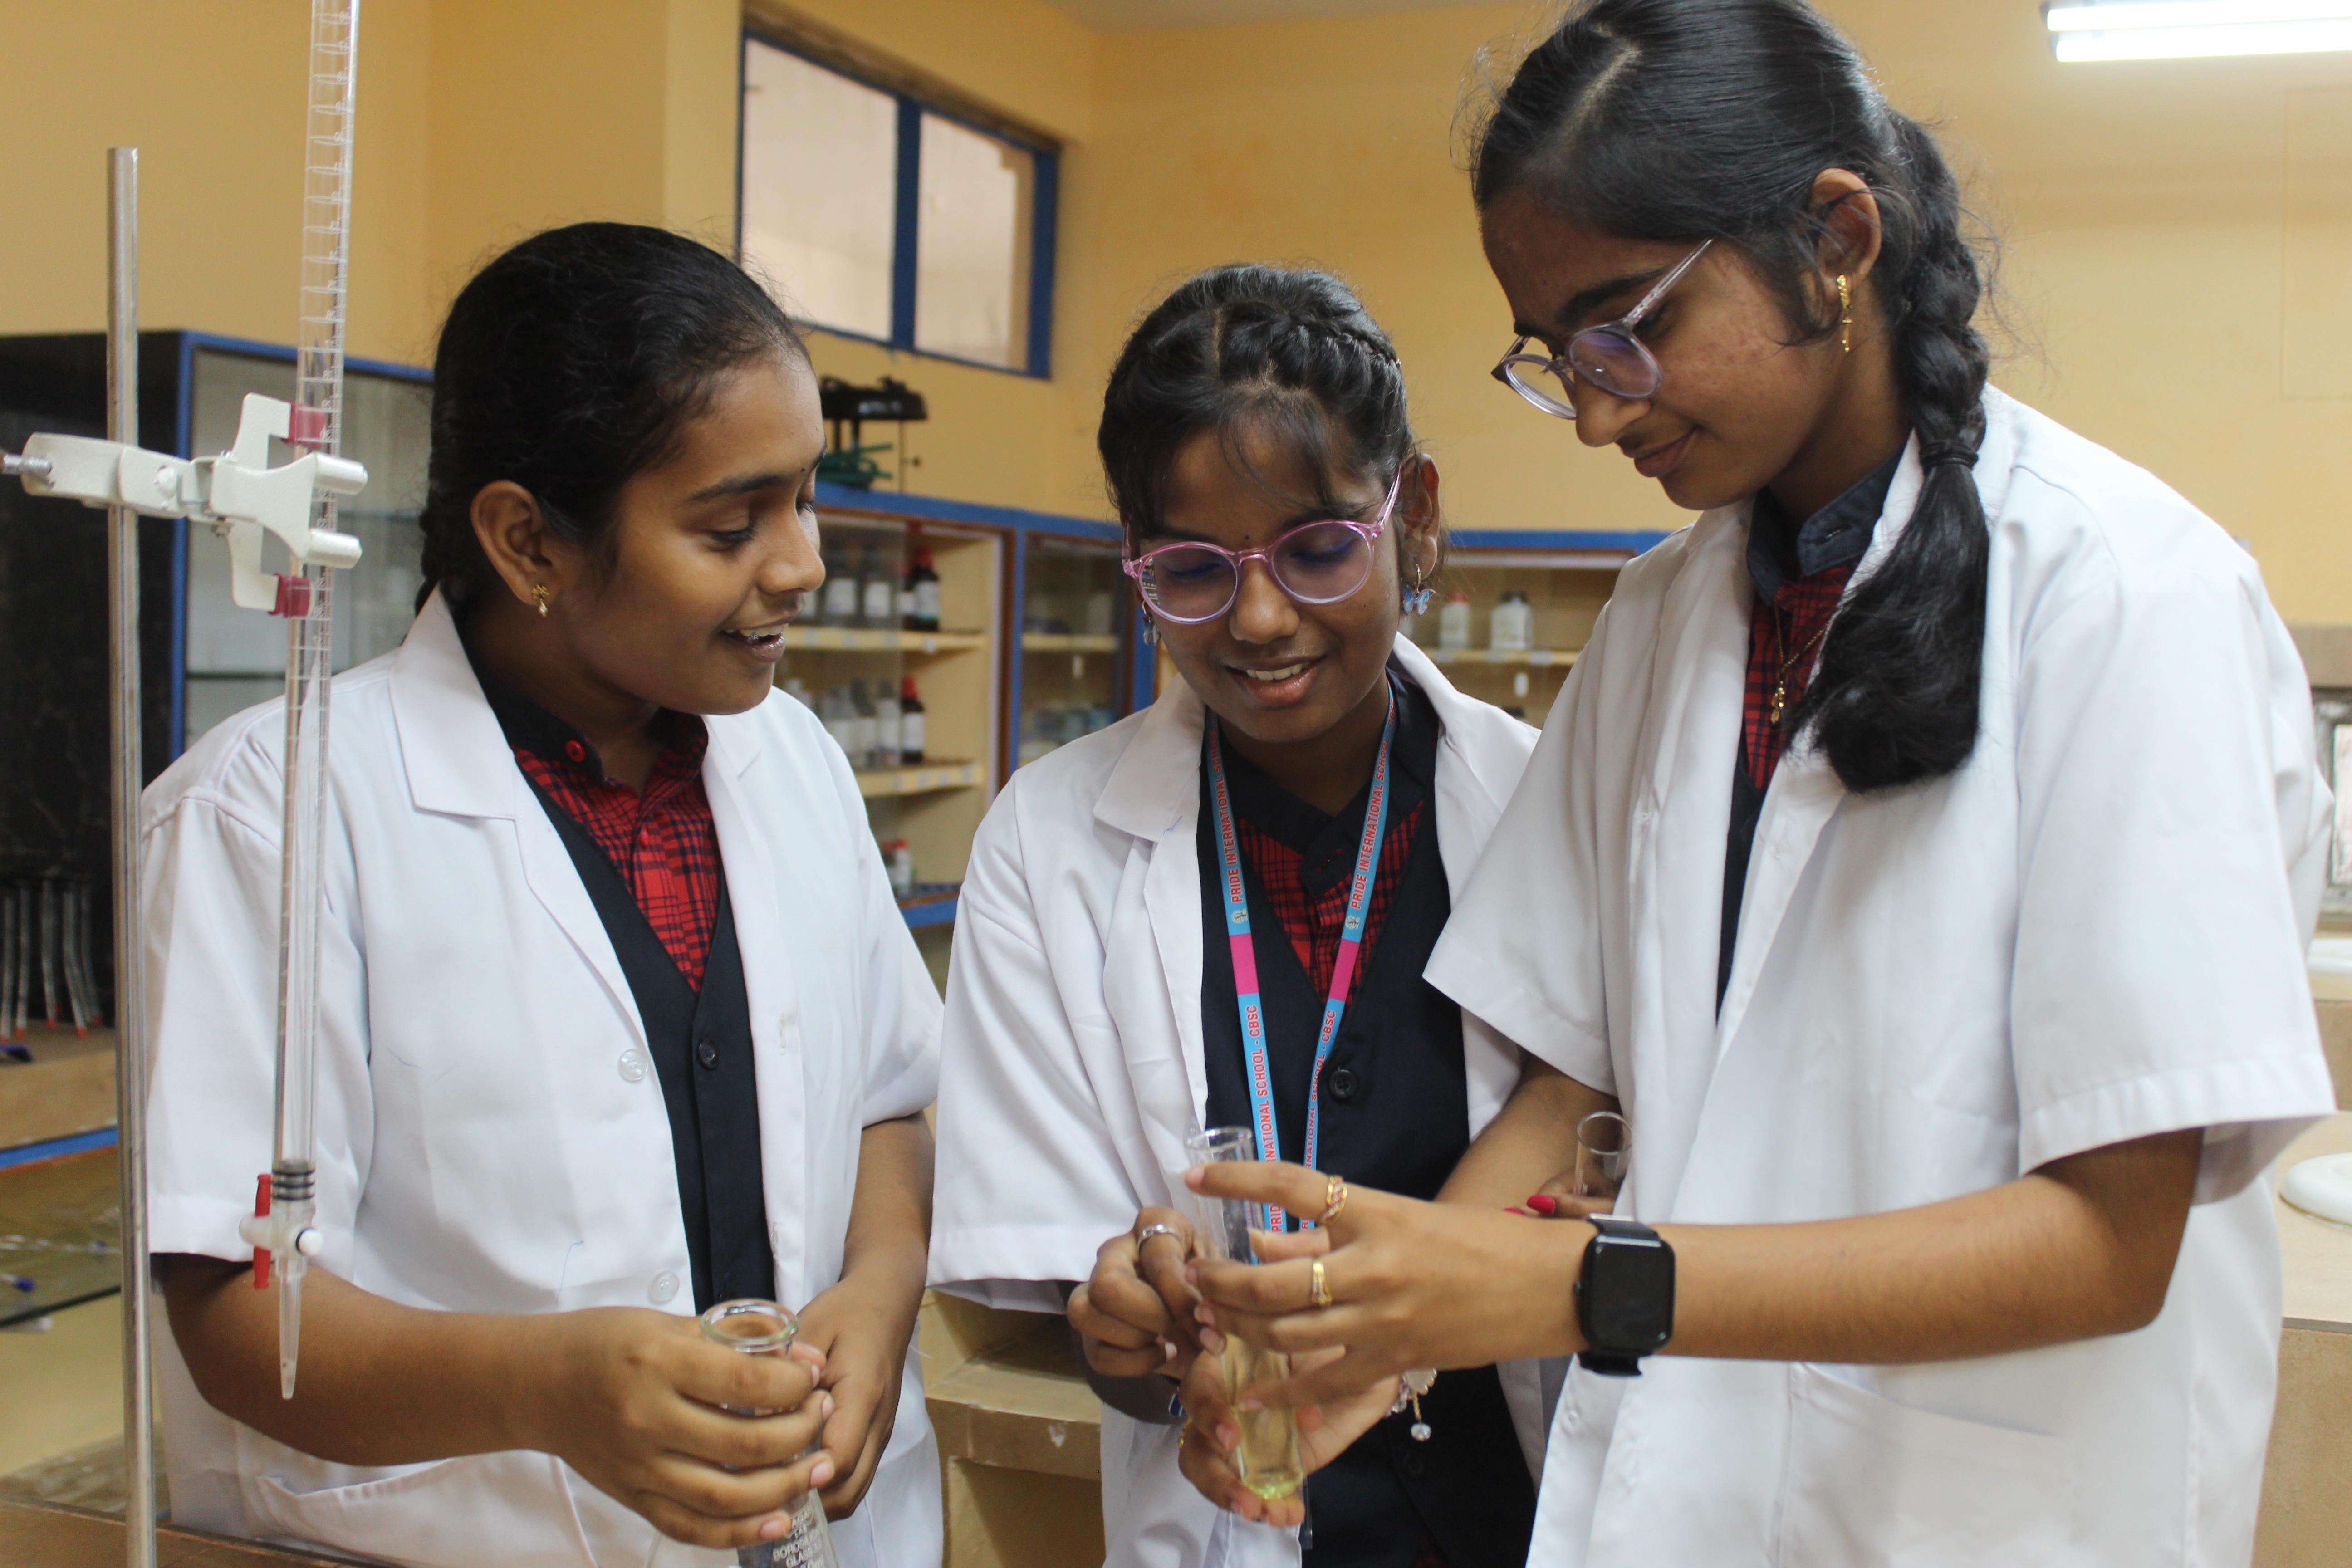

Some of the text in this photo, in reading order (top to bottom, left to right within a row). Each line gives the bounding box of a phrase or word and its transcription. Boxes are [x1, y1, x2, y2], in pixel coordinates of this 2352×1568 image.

[1209, 726, 1222, 773] SCHOOL
[1375, 739, 1390, 782] SCHOOL
[1215, 775, 1238, 865] INTERNATIONAL
[1358, 784, 1384, 872] INTERNATIONAL
[1227, 867, 1244, 903] PRIDE
[1351, 874, 1367, 909] PRIDE
[1246, 1004, 1261, 1038] CBSC
[1252, 1048, 1269, 1097] SCHOOL
[1306, 1105, 1315, 1170] RNATIONAL
[1311, 1054, 1326, 1101] SCHOOL
[1321, 1010, 1336, 1043] CBSC
[1258, 1099, 1277, 1163] RNATIONAL
[1270, 1204, 1283, 1232] PRID
